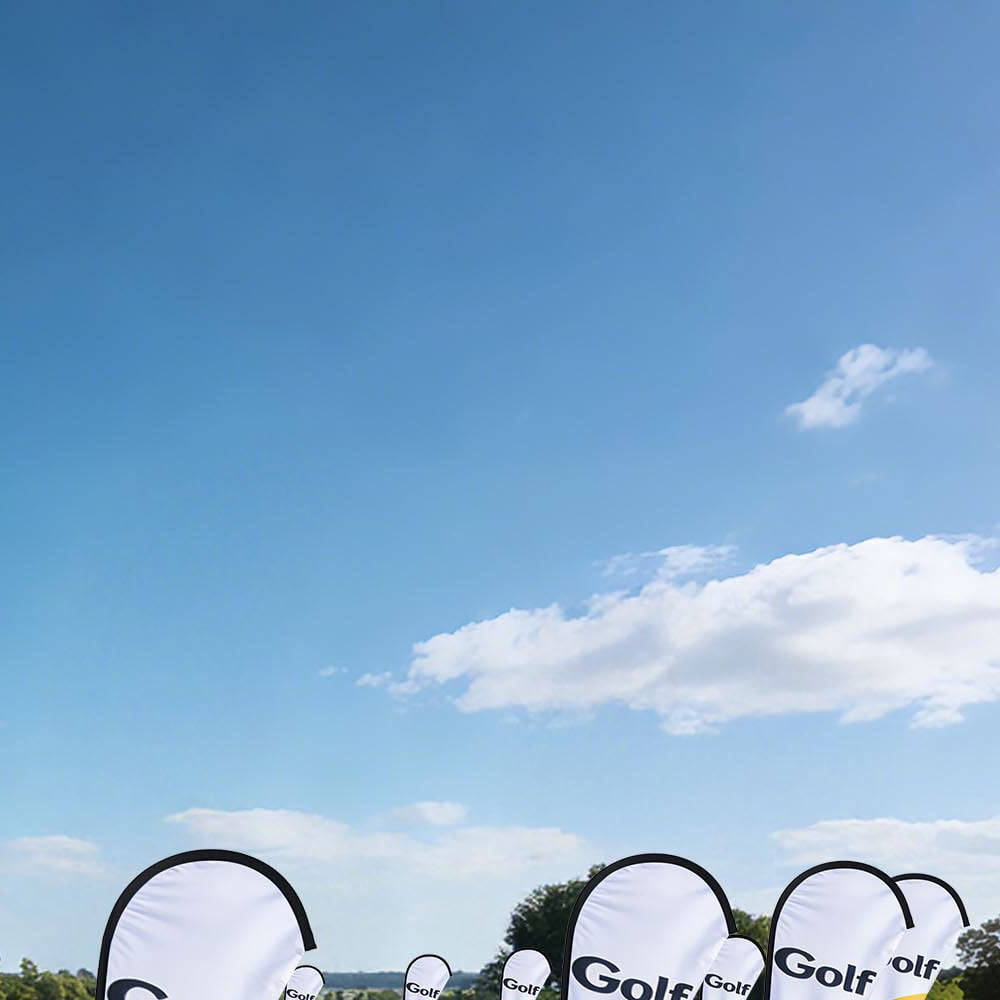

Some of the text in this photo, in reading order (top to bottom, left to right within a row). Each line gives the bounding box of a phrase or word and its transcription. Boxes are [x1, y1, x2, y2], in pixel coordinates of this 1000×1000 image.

[774, 946, 877, 995] Golf
[886, 954, 941, 980] olf
[405, 981, 441, 1000] Golf
[502, 977, 541, 997] Golf
[705, 973, 752, 996] Golf
